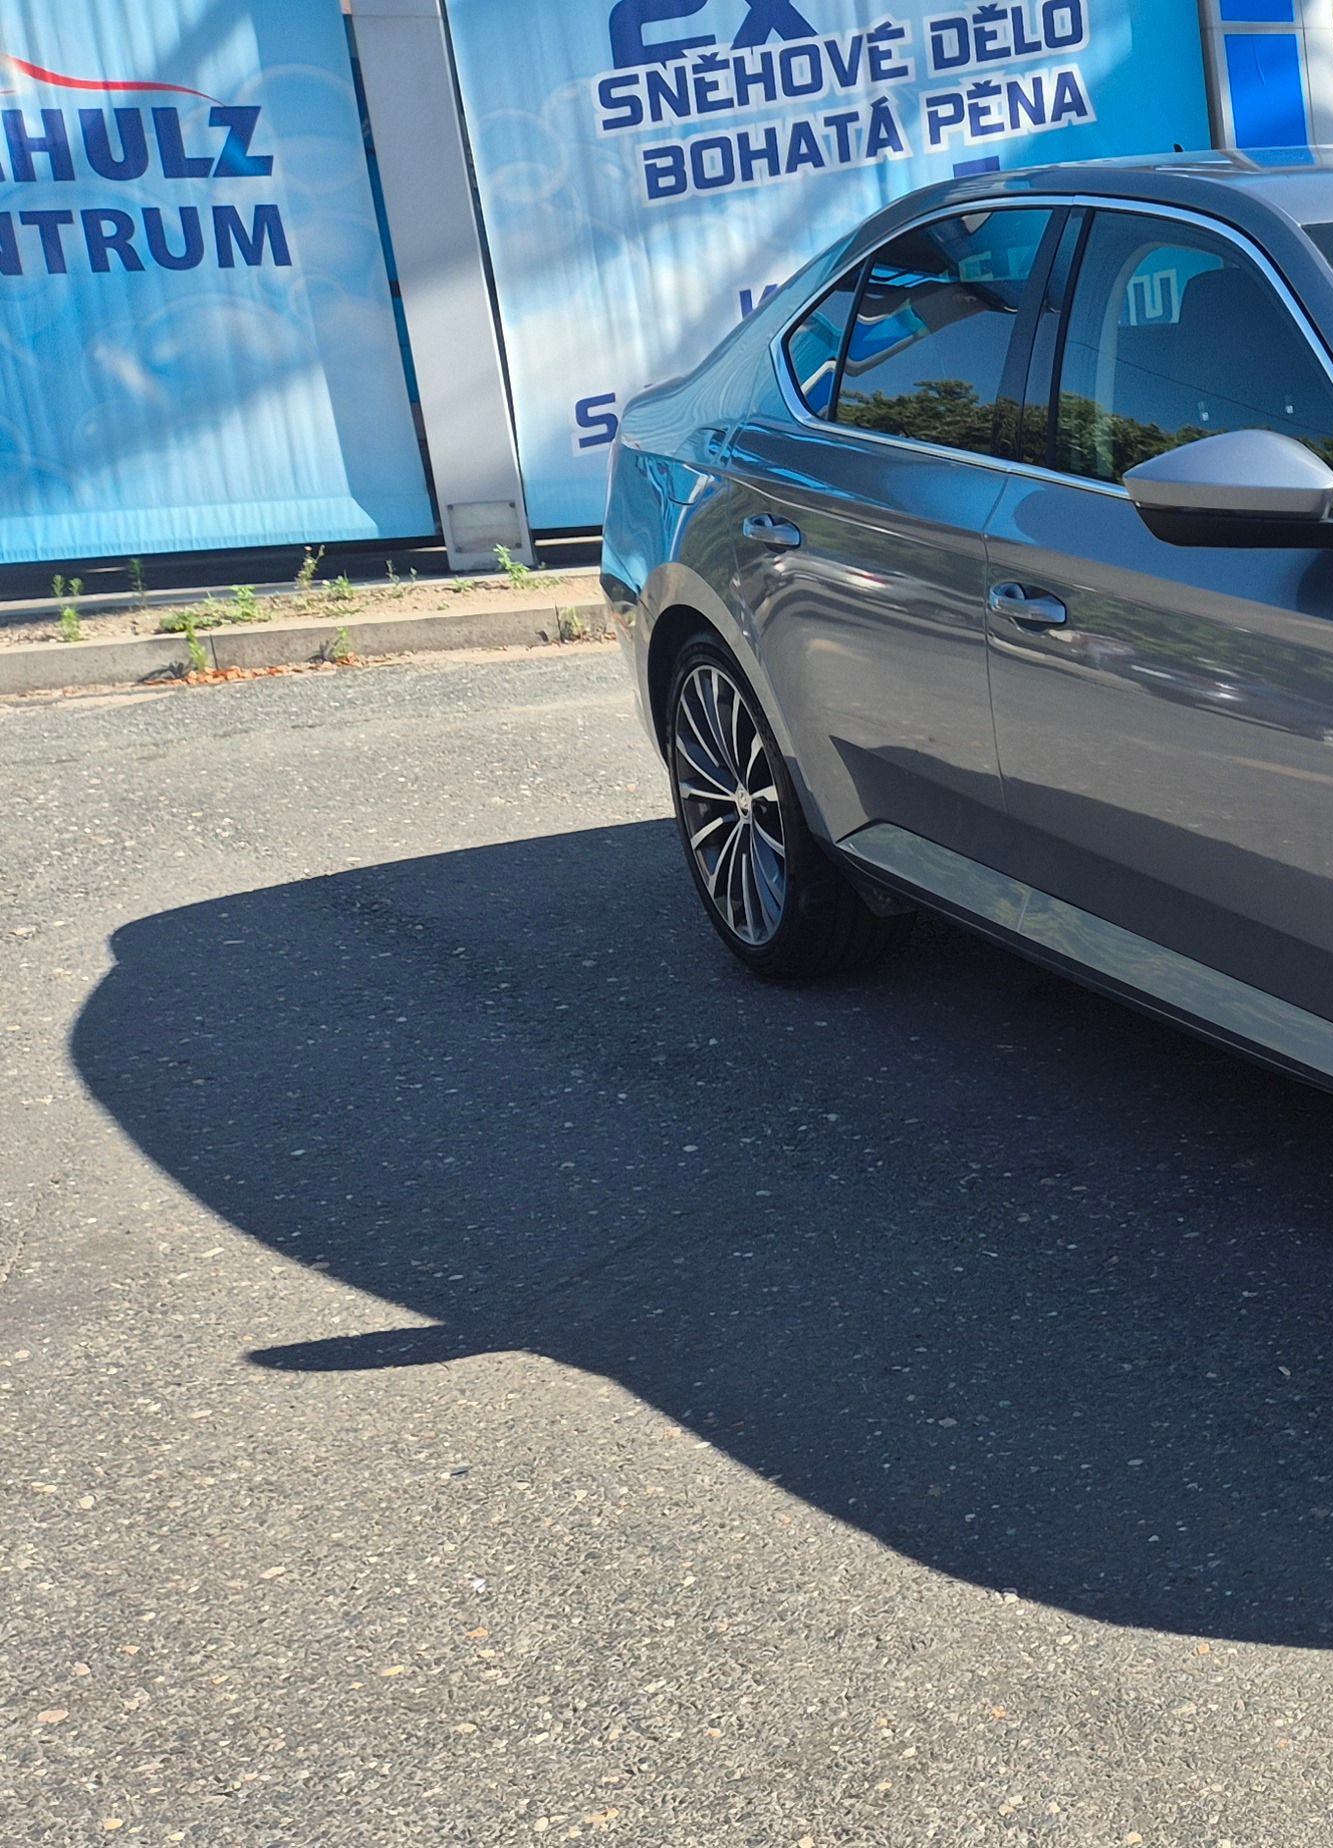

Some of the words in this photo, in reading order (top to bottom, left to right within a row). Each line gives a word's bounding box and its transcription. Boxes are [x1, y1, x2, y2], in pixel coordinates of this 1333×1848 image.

[598, 20, 909, 131] SNĚHOVÉ
[929, 0, 1084, 71] DĚLO
[0, 106, 274, 183] HULZ
[642, 96, 904, 200] BOHATÁ
[926, 71, 1088, 145] PĚNA
